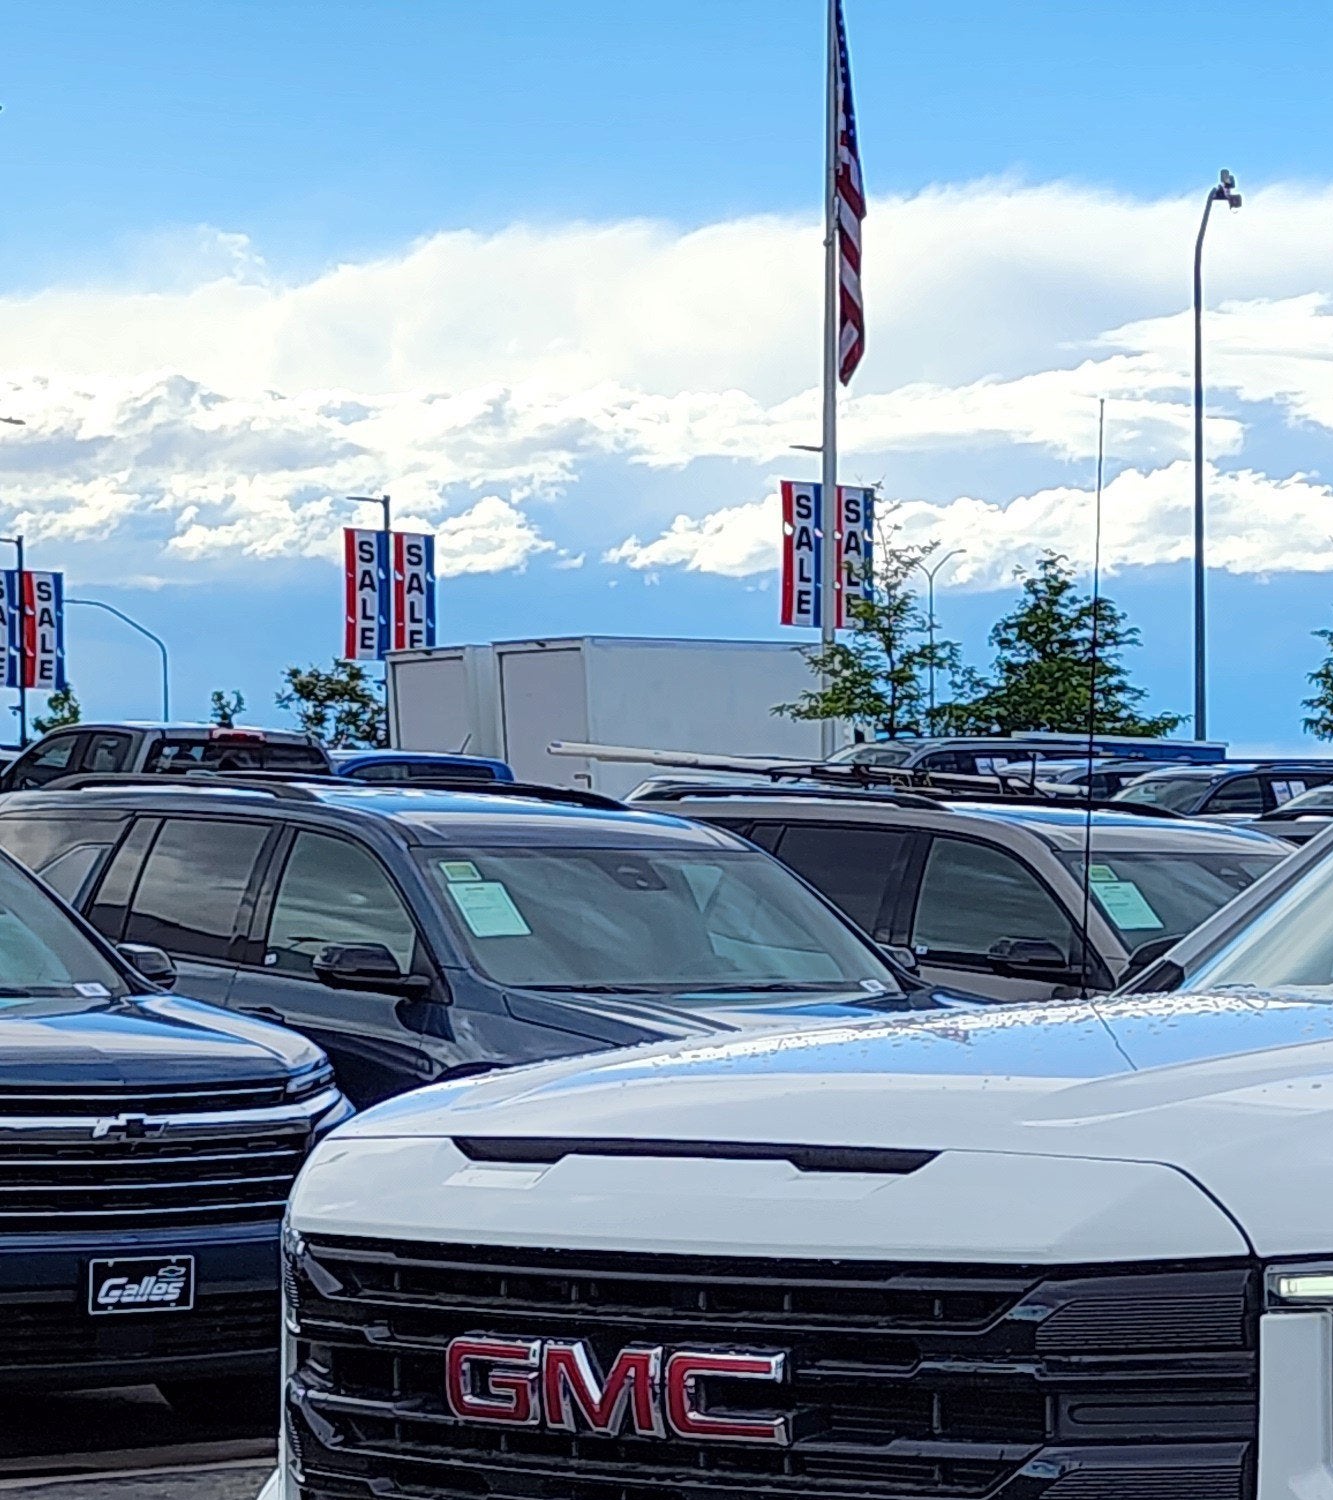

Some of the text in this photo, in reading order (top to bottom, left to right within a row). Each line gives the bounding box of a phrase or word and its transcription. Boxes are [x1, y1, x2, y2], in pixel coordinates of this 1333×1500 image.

[358, 540, 377, 650] SALE
[406, 543, 425, 649] SALE
[795, 494, 814, 615] SALE
[36, 581, 56, 681] SALE
[97, 1276, 185, 1304] Galles
[445, 1333, 795, 1448] GMC
